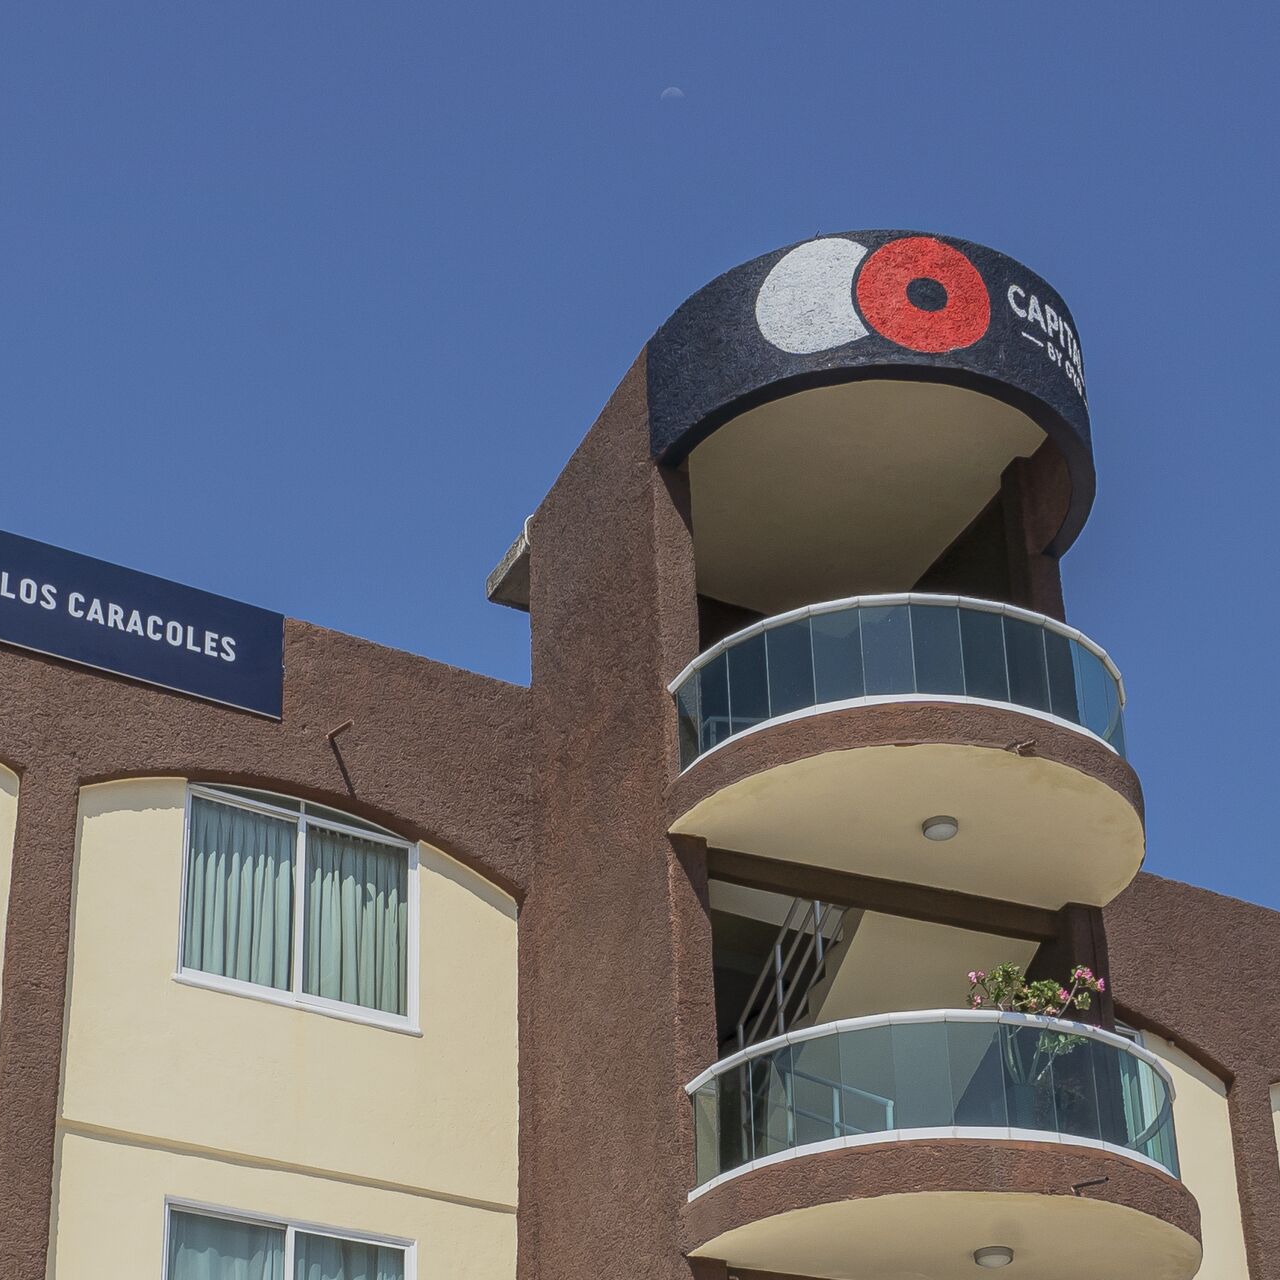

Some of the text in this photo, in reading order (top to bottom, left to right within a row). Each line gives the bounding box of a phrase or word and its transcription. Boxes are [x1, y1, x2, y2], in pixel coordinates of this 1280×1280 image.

[1047, 341, 1062, 367] BY
[0, 571, 236, 662] LOS CARACOLES
